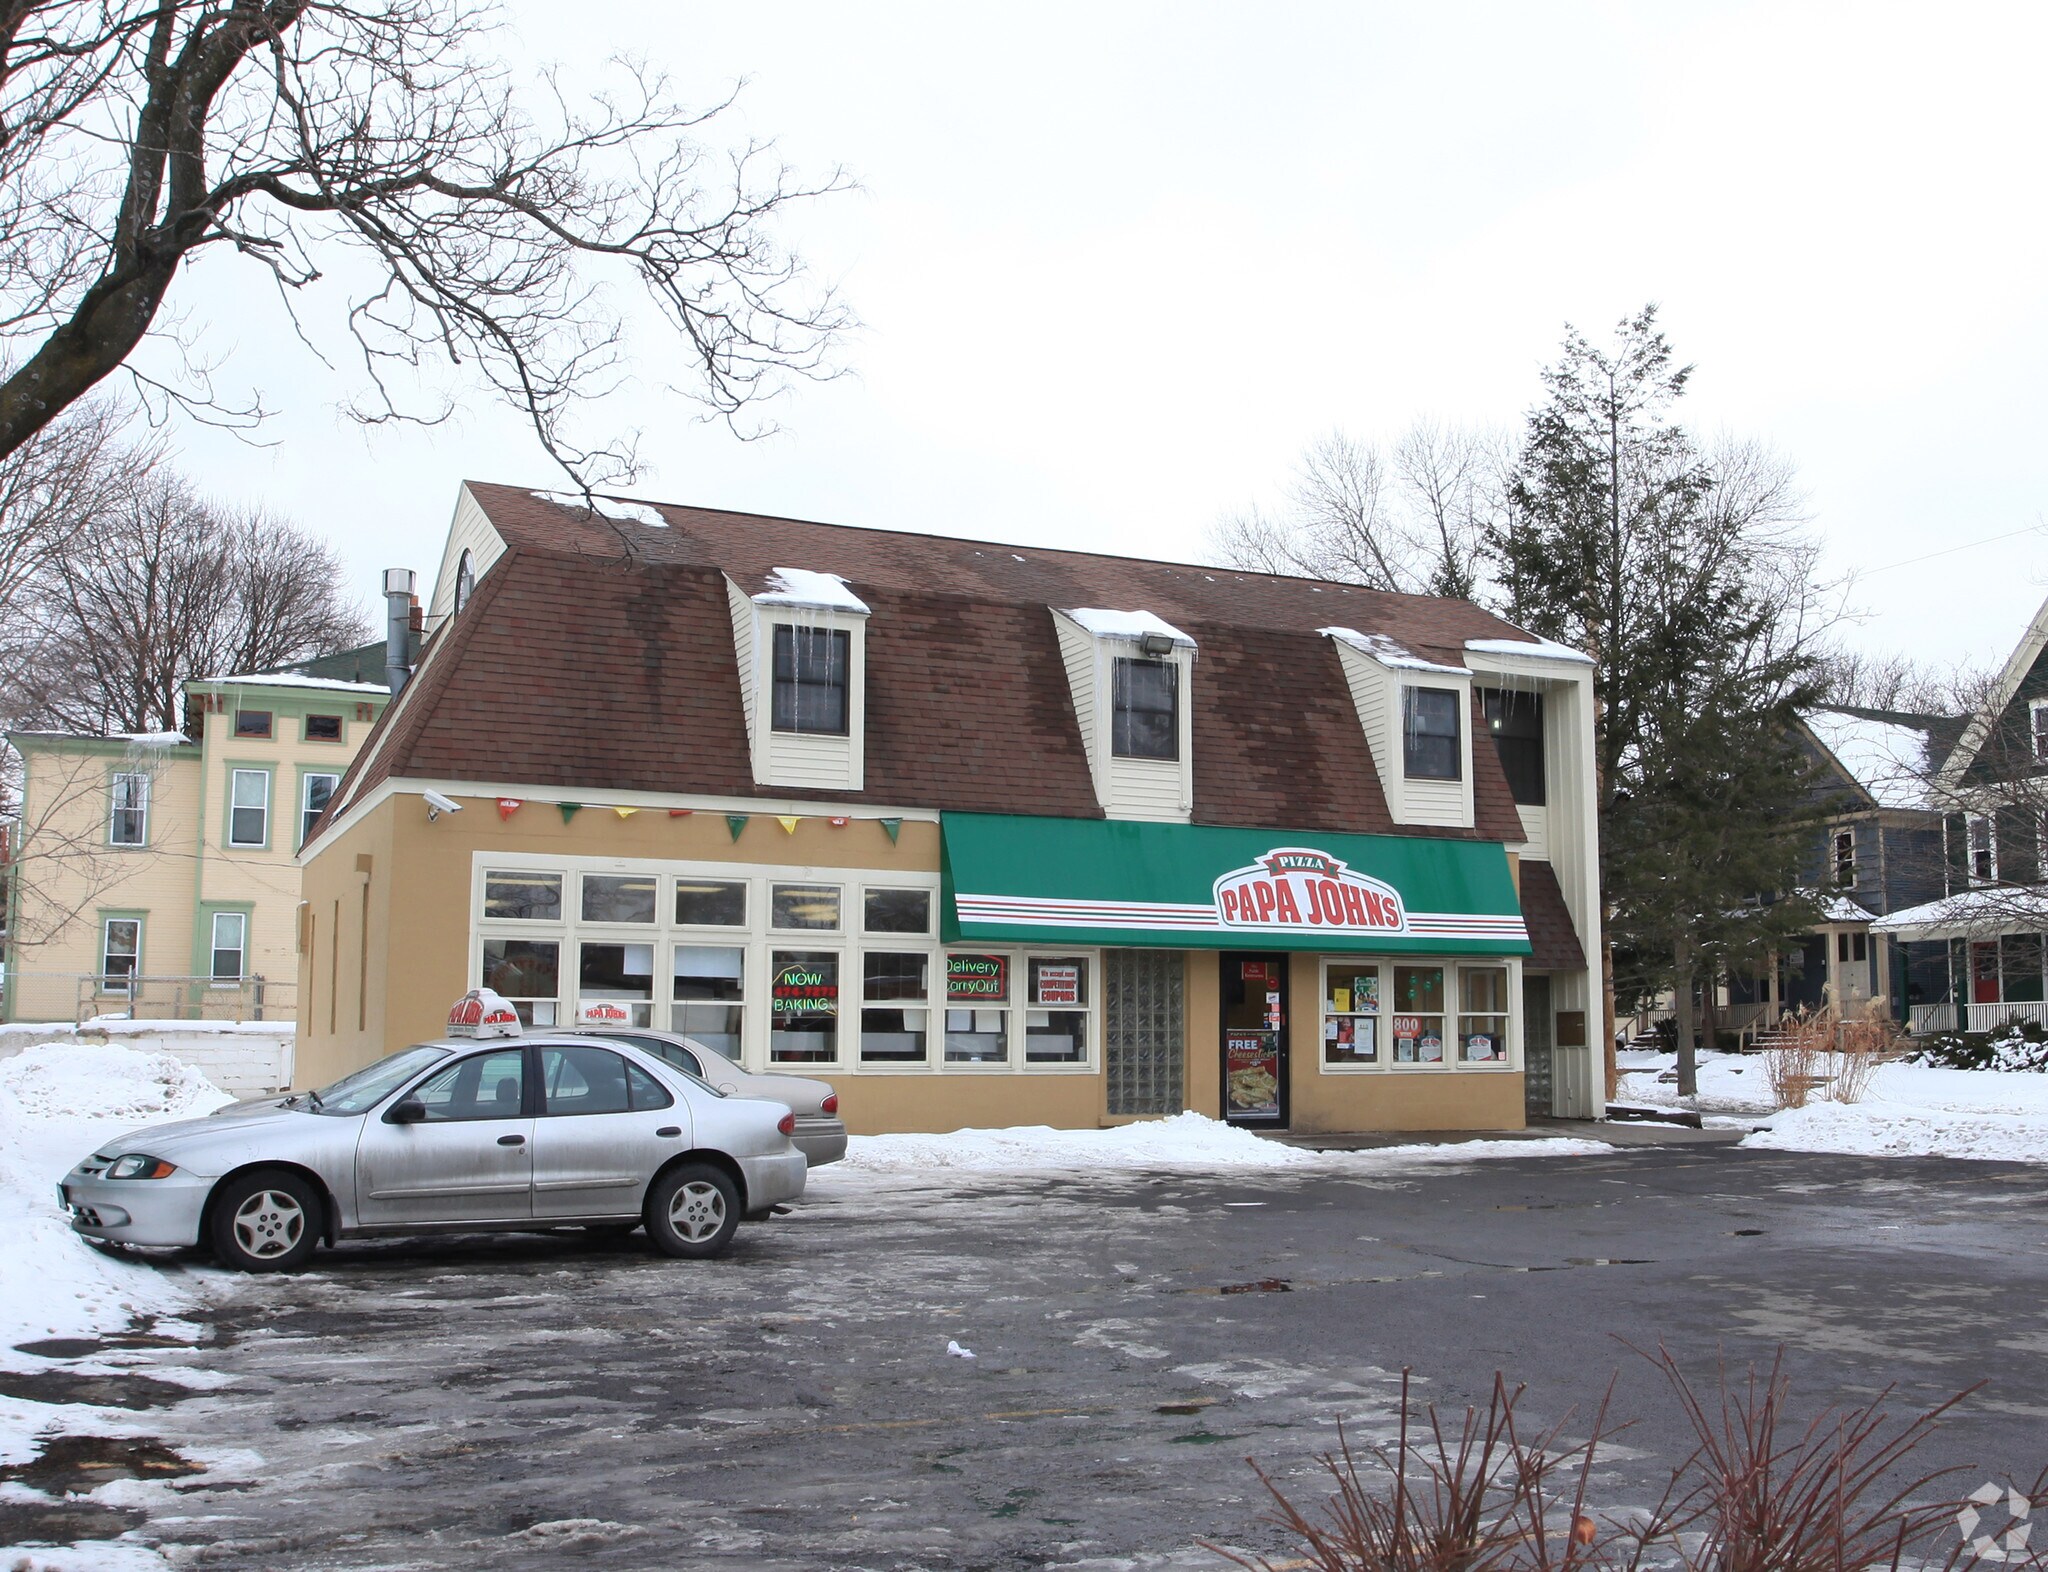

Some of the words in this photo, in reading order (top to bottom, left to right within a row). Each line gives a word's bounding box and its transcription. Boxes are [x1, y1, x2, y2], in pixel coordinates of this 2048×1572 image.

[1278, 855, 1325, 870] PIZZA
[1221, 879, 1302, 923] PAPA
[1304, 879, 1399, 928] JOHN'S
[947, 959, 999, 977] Delivery
[784, 973, 822, 985] NOW
[774, 997, 829, 1012] BAKING
[1393, 1017, 1419, 1031] 800
[1228, 1040, 1258, 1050] FREE
[1228, 1048, 1276, 1059] Cheesesticks
